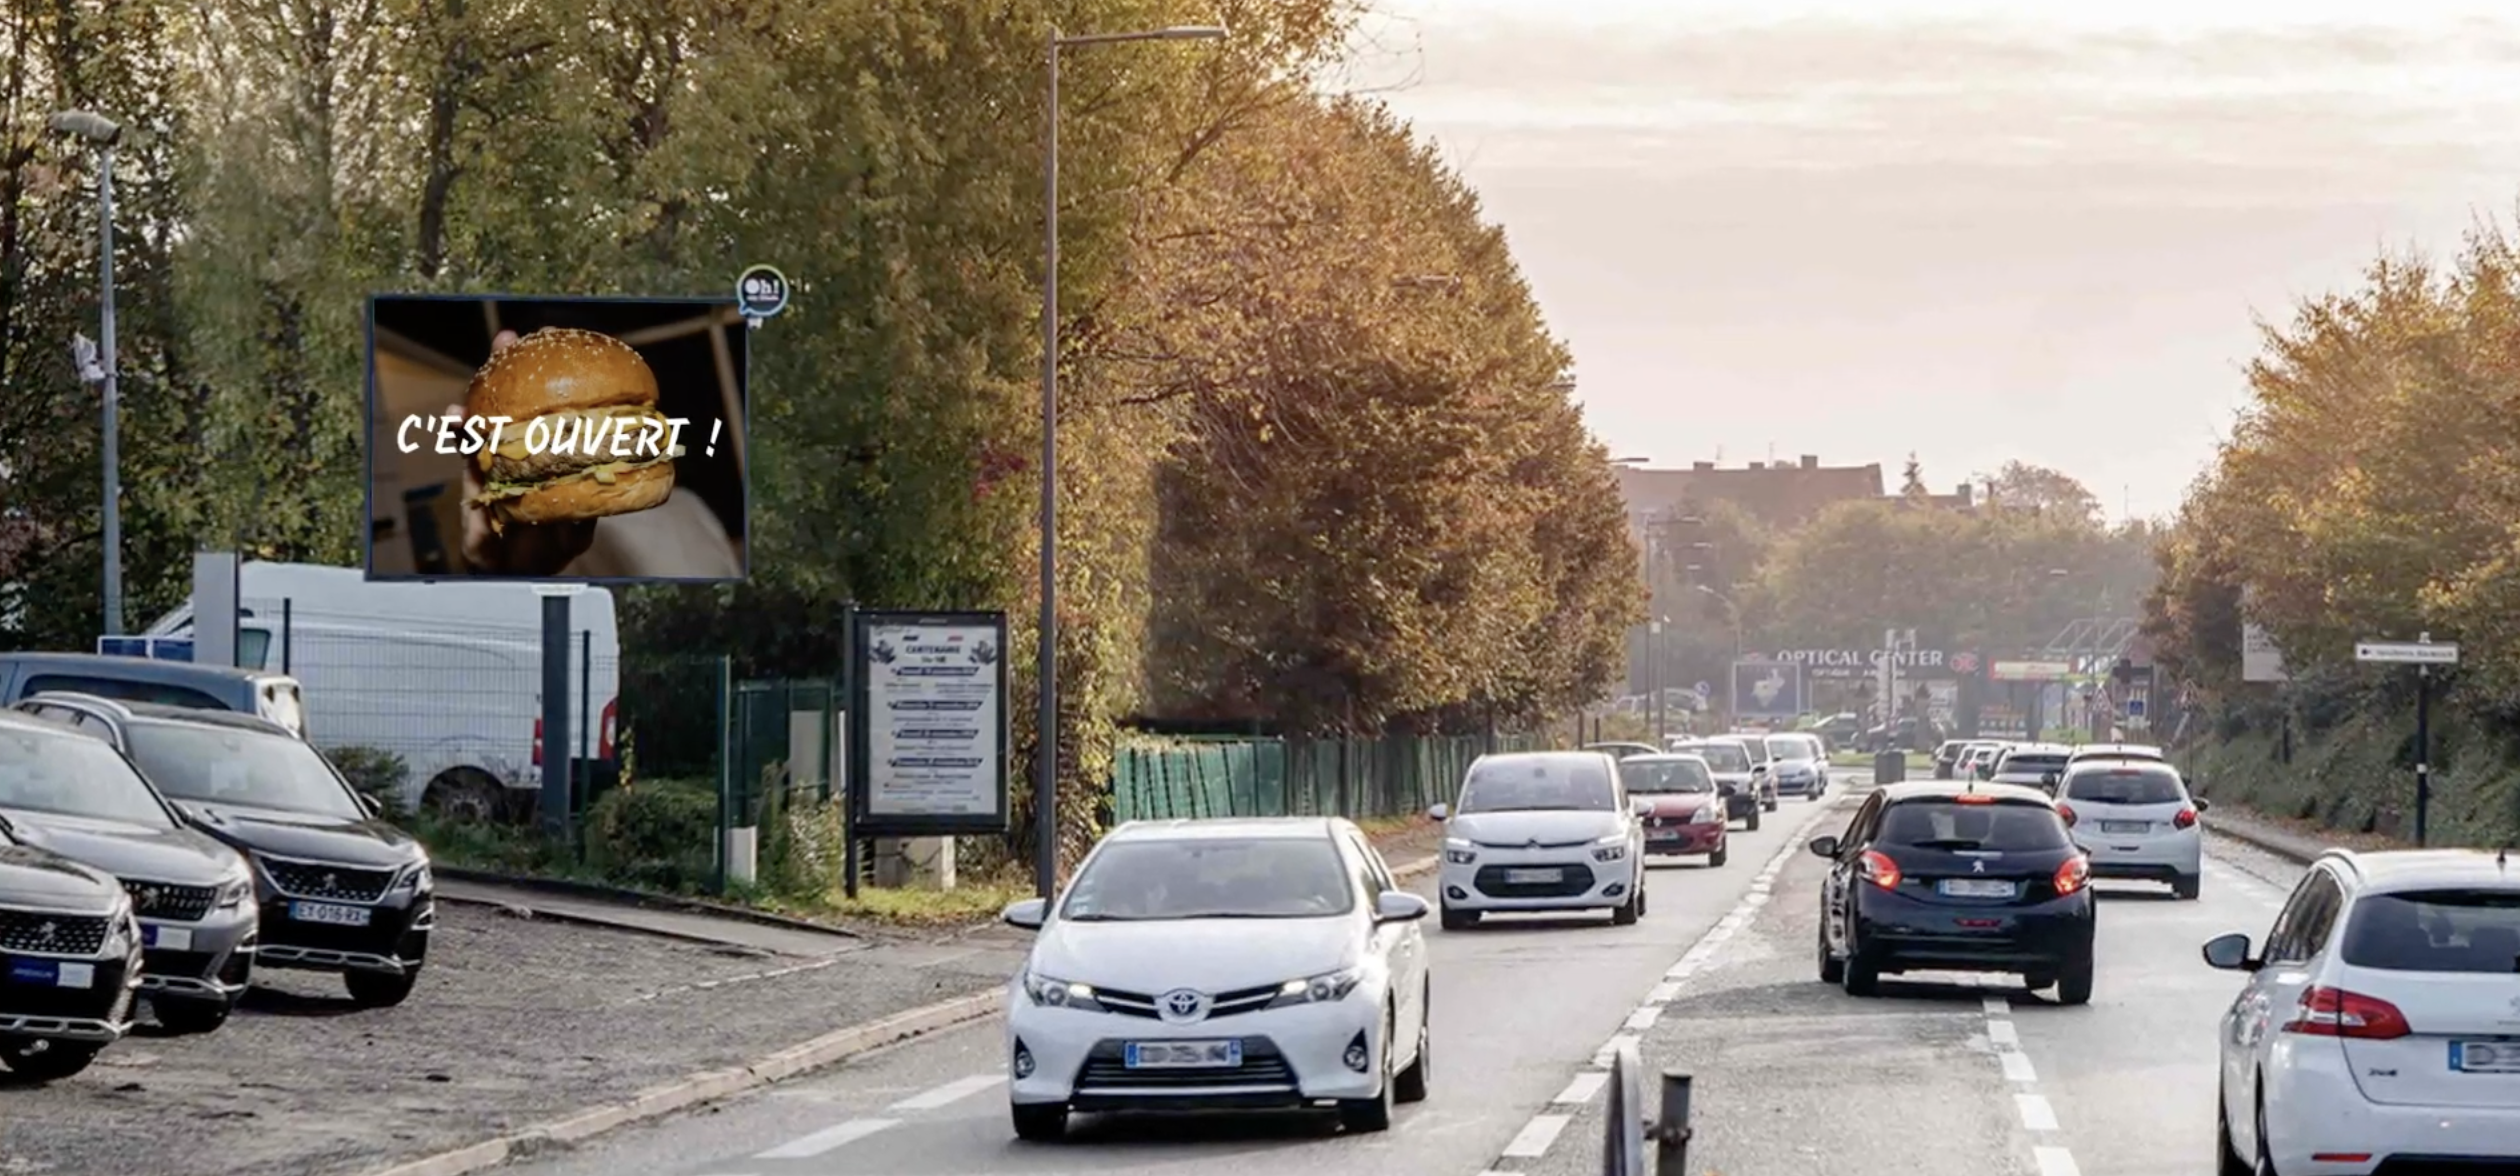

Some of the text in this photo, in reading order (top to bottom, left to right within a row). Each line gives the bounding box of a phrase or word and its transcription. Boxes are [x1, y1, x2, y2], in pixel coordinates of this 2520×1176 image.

[745, 278, 780, 295] Oh!
[397, 413, 722, 458] C'EST OUVERT !
[1777, 649, 1863, 666] OPTICAL
